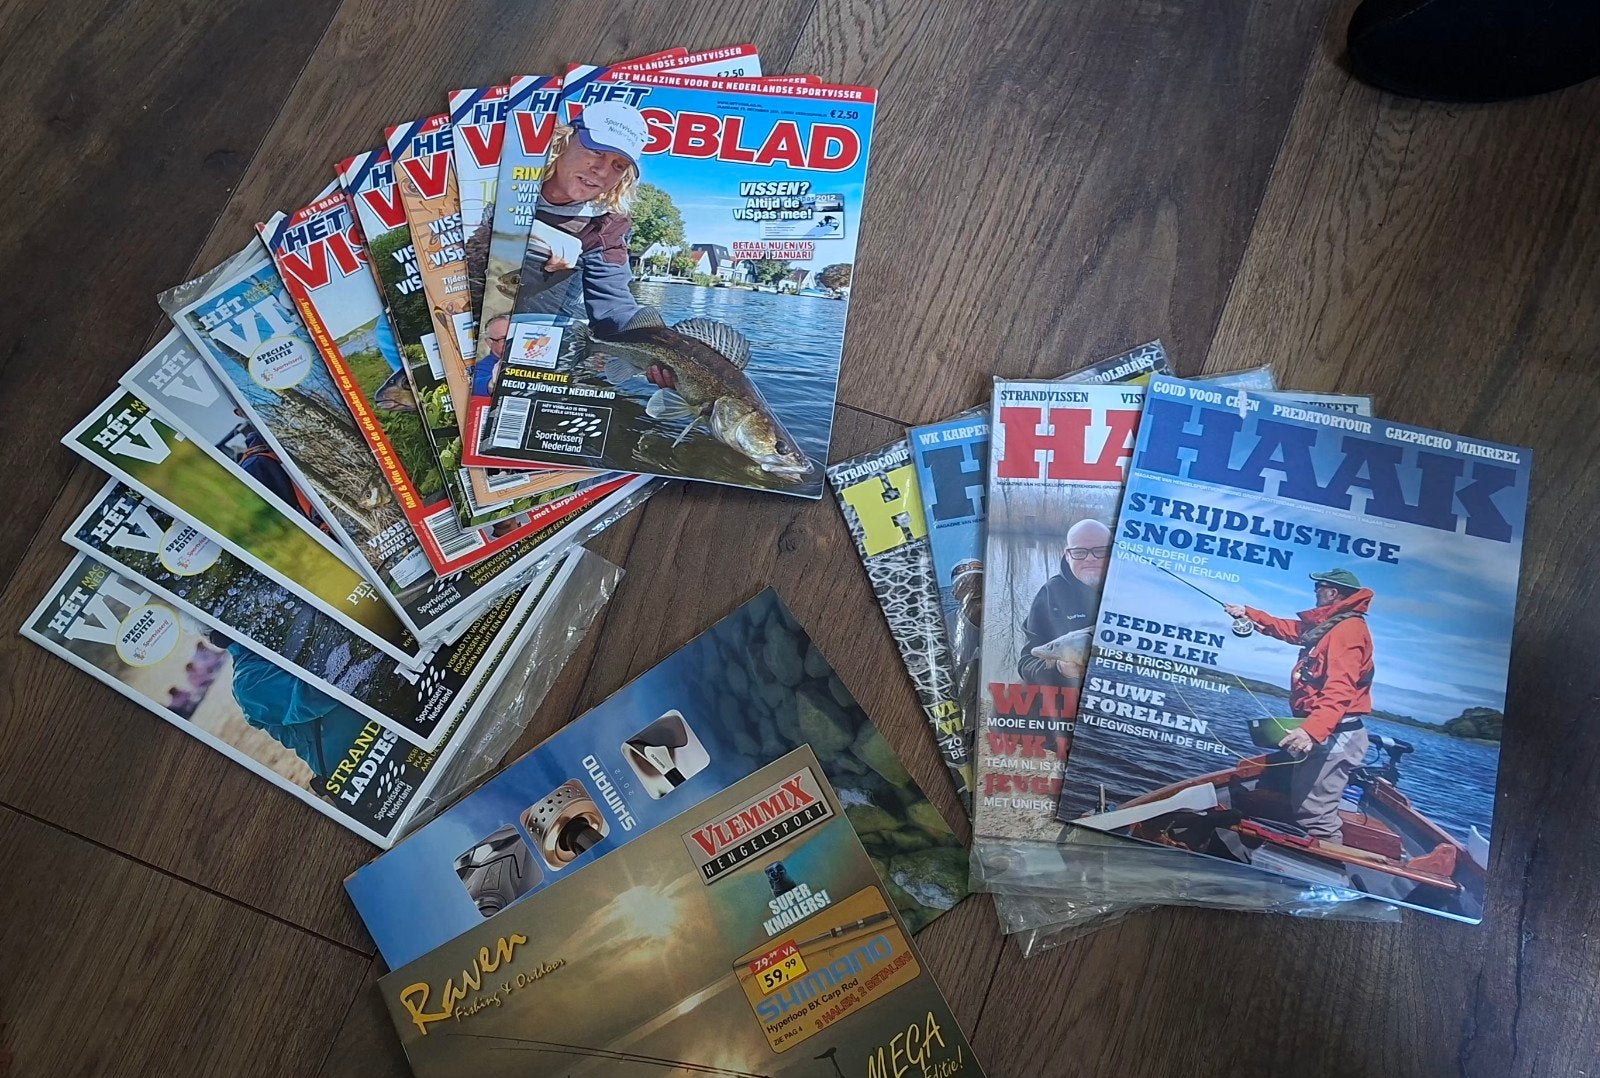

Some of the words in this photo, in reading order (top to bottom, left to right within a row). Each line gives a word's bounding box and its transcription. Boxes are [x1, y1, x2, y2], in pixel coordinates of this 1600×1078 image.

[678, 48, 742, 65] SPORTVISSER
[612, 72, 630, 80] HET
[632, 74, 681, 86] MAGAZINE
[684, 78, 710, 88] VOOR
[726, 83, 794, 94] NEDERLANDSE
[796, 86, 862, 100] SPORTVISSER
[565, 100, 861, 172] SBLAD
[740, 181, 811, 196] VISSEN?
[746, 198, 780, 210] Altijd
[784, 198, 800, 208] de
[283, 202, 348, 252] HÉT
[300, 206, 318, 218] HET
[780, 208, 812, 220] mee!
[732, 242, 766, 250] BETAAL
[768, 242, 780, 250] NU
[783, 242, 796, 250] EN
[798, 242, 814, 250] VIS
[735, 251, 765, 260] VANAF
[773, 252, 812, 260] JANUARI
[199, 296, 245, 330] HÉT
[256, 340, 294, 362] SPECIALE
[318, 334, 328, 347] van
[148, 348, 191, 390] HÉT
[264, 349, 293, 365] EDITIE
[324, 346, 344, 375] moment
[502, 379, 526, 390] REGIO
[526, 382, 568, 394] ZUIDWEST
[569, 386, 616, 400] NEDERLAND
[504, 368, 542, 380] SPECIALE
[542, 372, 570, 384] EDITIE
[348, 390, 366, 417] boeken
[1000, 390, 1089, 403] STRANDVISSEN
[1153, 381, 1186, 398] GOUD
[1188, 388, 1223, 405] VOOR
[92, 408, 138, 448] HÉT
[362, 415, 374, 431] drie
[370, 431, 380, 441] de
[535, 430, 584, 445] Sportvisserij
[1272, 404, 1372, 434] PREDATORTOUR
[1386, 427, 1452, 450] GAZPACHO
[1456, 440, 1520, 464] MAKREEL
[376, 441, 388, 455] van
[542, 440, 582, 452] Nederland
[919, 433, 940, 446] WK
[1136, 398, 1517, 544] HAAK
[398, 483, 407, 492] &
[90, 496, 134, 542] HÉT
[533, 508, 550, 520] met
[1128, 492, 1401, 565] STRIJDLUSTIGE
[473, 558, 510, 587] SPOTLIGHTS
[516, 543, 530, 556] HOE
[529, 532, 547, 547] VANG
[1118, 541, 1145, 554] GIJS
[1146, 546, 1208, 566] NEDERLOF
[1123, 519, 1294, 571] SNOEKEN
[468, 548, 513, 580] KARPERVISSEN
[1116, 551, 1155, 566] VANGT
[1158, 560, 1173, 571] ZE
[1175, 562, 1186, 574] IN
[1188, 564, 1240, 584] IERLAND
[48, 586, 90, 634] HÉT
[417, 586, 458, 614] Sportvisserij
[428, 592, 462, 617] Nederland
[122, 609, 154, 644] SPECIALE
[131, 618, 156, 644] EDITIE
[478, 609, 498, 634] PRECIES
[1102, 611, 1225, 648] FEEDEREN
[445, 642, 466, 669] VISBLAD
[460, 654, 478, 677] VISSEN
[473, 631, 493, 656] VANUIT
[490, 618, 500, 632] EEN
[1098, 647, 1124, 662] TIPS
[1126, 652, 1134, 662] &
[1136, 654, 1172, 670] TRICS
[1174, 662, 1199, 676] VAN
[1100, 629, 1132, 646] OP
[1136, 636, 1168, 656] DE
[1172, 644, 1219, 666] LEK
[1089, 676, 1166, 706] SLUWE
[1096, 658, 1134, 674] PETER
[1136, 666, 1160, 679] VAN
[1162, 672, 1188, 686] DER
[1190, 678, 1231, 694] WILLIK
[416, 685, 446, 724] Sportvisserij
[428, 688, 453, 722] Nederland
[1084, 694, 1209, 735] FORELLEN
[987, 718, 1026, 729] MOOIE
[1029, 720, 1045, 730] EN
[1082, 714, 1158, 740] VLIEGVISSEN
[1160, 732, 1174, 743] IN
[1176, 735, 1194, 748] DE
[1196, 740, 1230, 756] EIFEL
[326, 720, 382, 794] STRAND
[341, 728, 400, 806] LADIES
[986, 758, 1018, 770] TEAM
[1021, 760, 1037, 771] NL
[1040, 761, 1050, 770] IS
[374, 780, 406, 820] Sportvisserij
[386, 785, 412, 819] Nederland
[582, 754, 636, 832] SHIMANO
[984, 796, 1008, 807] MET
[691, 776, 815, 857] VLEMMIX
[704, 804, 825, 877] HENGELSPORT
[762, 890, 832, 937] KNALLERS!
[768, 883, 812, 915] SUPER
[400, 933, 528, 1036] Raven
[455, 992, 503, 1023] Fishing
[501, 981, 513, 995] &
[516, 958, 567, 988] Outdoor
[756, 934, 894, 1024] SHIMANO
[766, 1006, 808, 1034] Hyperloop
[808, 998, 822, 1011] BX
[822, 989, 842, 1004] Carp
[842, 978, 860, 992] Rod
[774, 1036, 784, 1046] ZIE
[784, 1030, 798, 1042] PAG
[868, 1011, 945, 1078] MEGA
